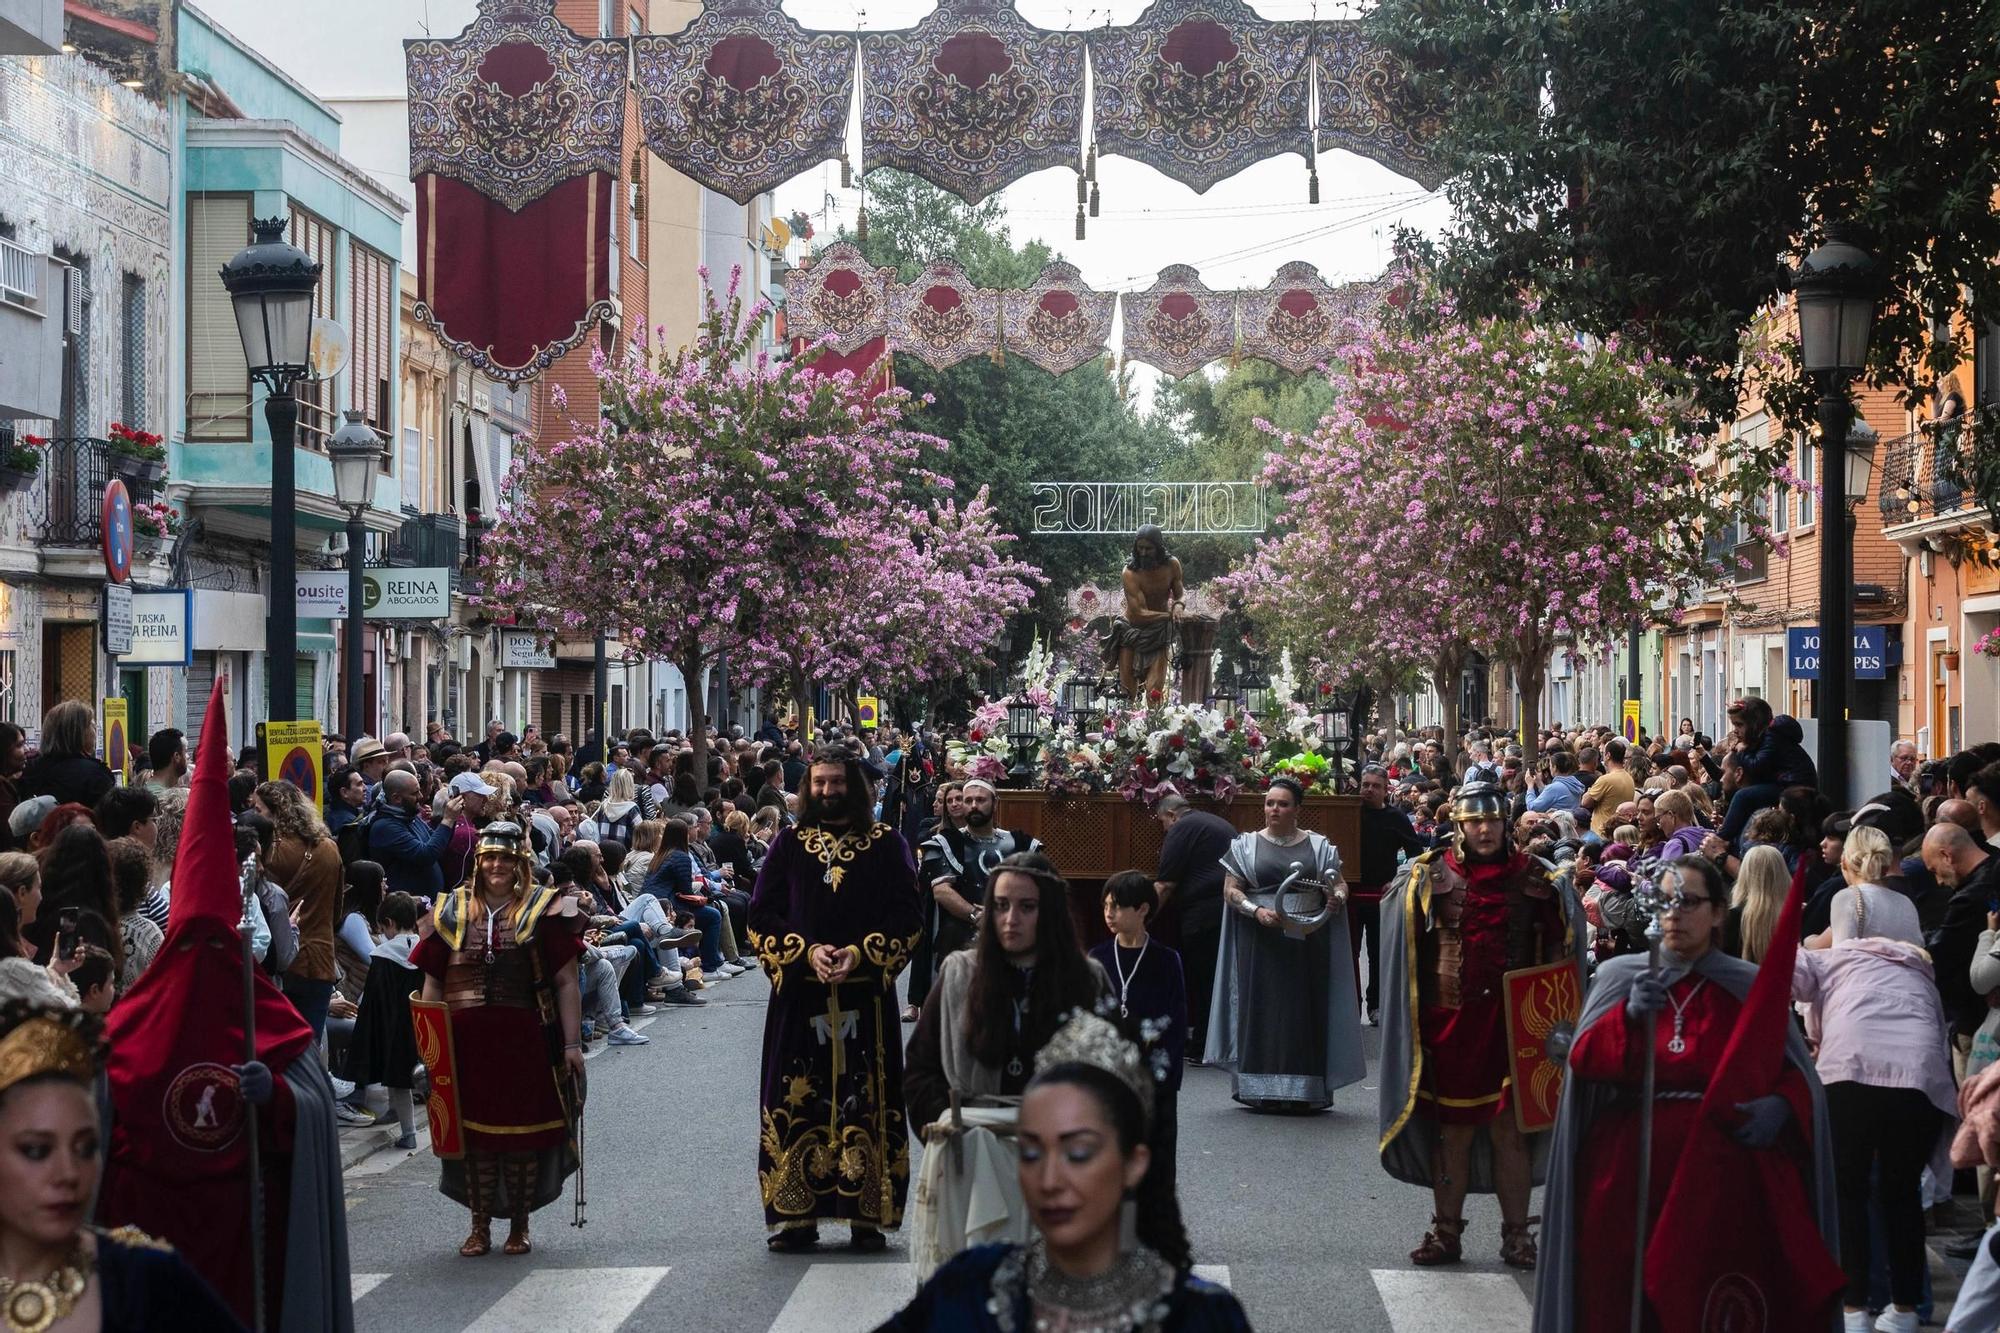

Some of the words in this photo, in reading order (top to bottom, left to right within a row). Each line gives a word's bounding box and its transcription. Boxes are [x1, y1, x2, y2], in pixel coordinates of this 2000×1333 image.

[296, 579, 344, 598] ousite
[387, 581, 439, 595] REINA
[387, 596, 439, 605] ABOGADOS
[136, 613, 166, 623] TASKA
[131, 624, 140, 636] A
[142, 624, 178, 638] REINA
[1802, 636, 1871, 649] JOIA
[511, 649, 548, 658] Seguros
